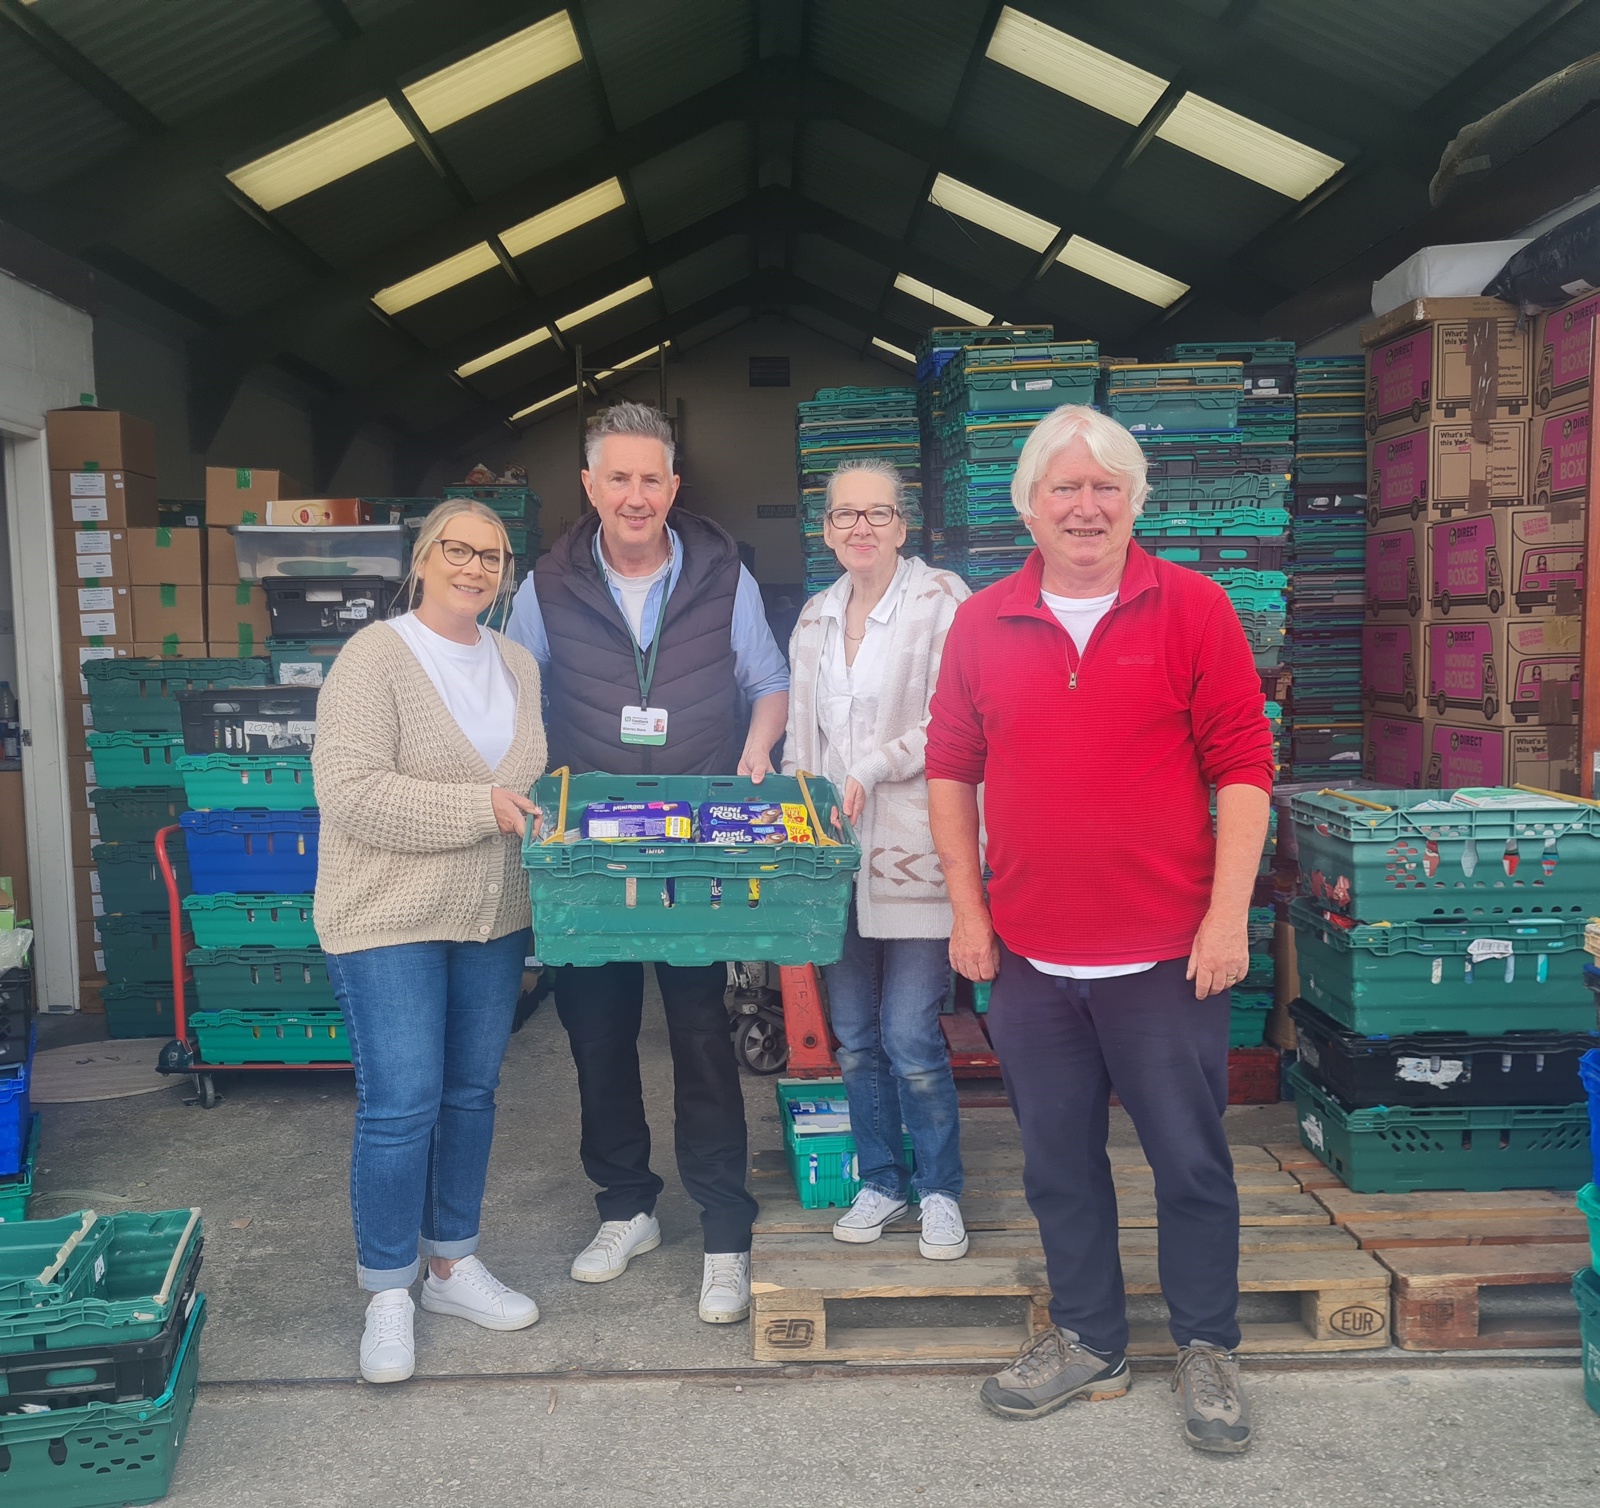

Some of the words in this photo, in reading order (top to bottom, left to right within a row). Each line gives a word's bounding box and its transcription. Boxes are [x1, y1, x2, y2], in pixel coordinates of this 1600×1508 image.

[1573, 302, 1598, 321] DIRECT
[1440, 431, 1463, 439] What's
[1457, 525, 1478, 539] DIRECT
[1447, 548, 1479, 566] MOVING
[1447, 567, 1479, 587] BOXES
[1455, 631, 1475, 642] DIRECT
[1444, 654, 1476, 668] MOVING
[1444, 670, 1476, 689] BOXES
[1460, 734, 1483, 747] DIRECT
[1516, 737, 1542, 745] What's
[1448, 755, 1483, 773] MOVING
[1341, 1311, 1374, 1331] EUR
